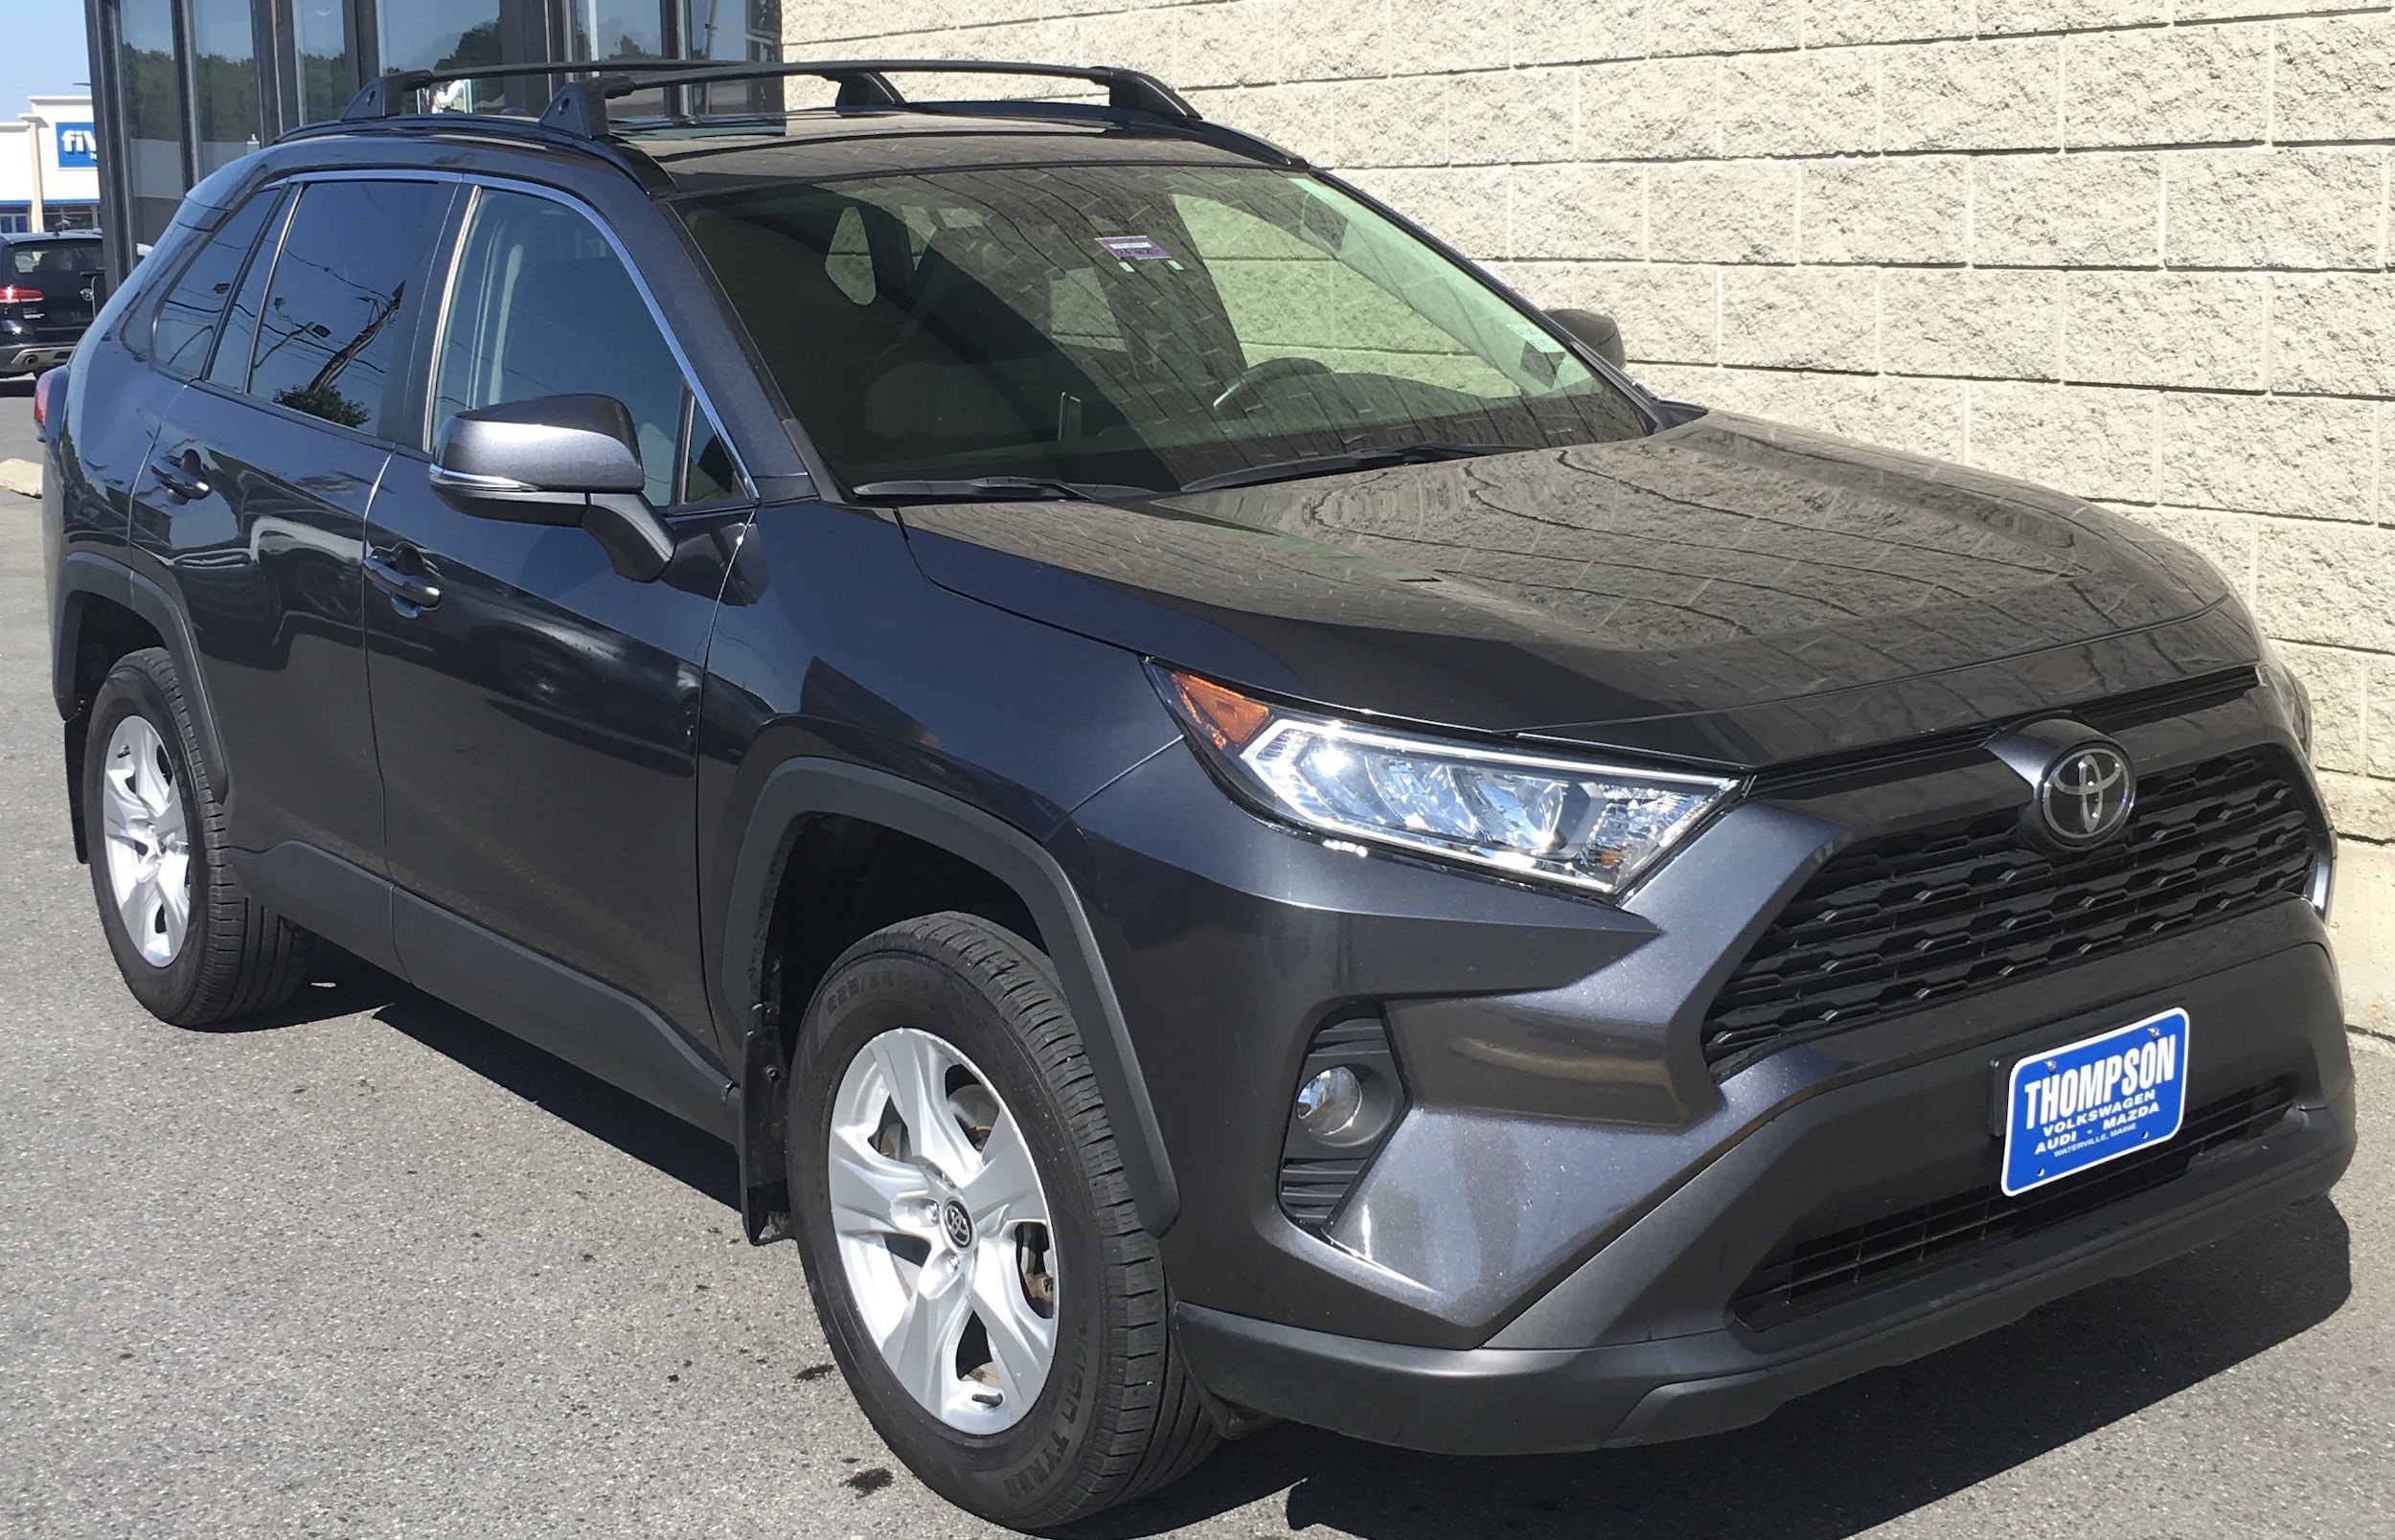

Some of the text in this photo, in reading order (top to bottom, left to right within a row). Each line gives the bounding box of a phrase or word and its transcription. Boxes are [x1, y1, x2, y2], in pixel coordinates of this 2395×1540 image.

[2024, 1034, 2176, 1130] THOMPSON
[2035, 1131, 2077, 1155] AUDI
[2103, 1102, 2159, 1131] MAZDA
[2043, 1089, 2156, 1137] VOLKSWAGEN
[2110, 1122, 2137, 1138] MAINE
